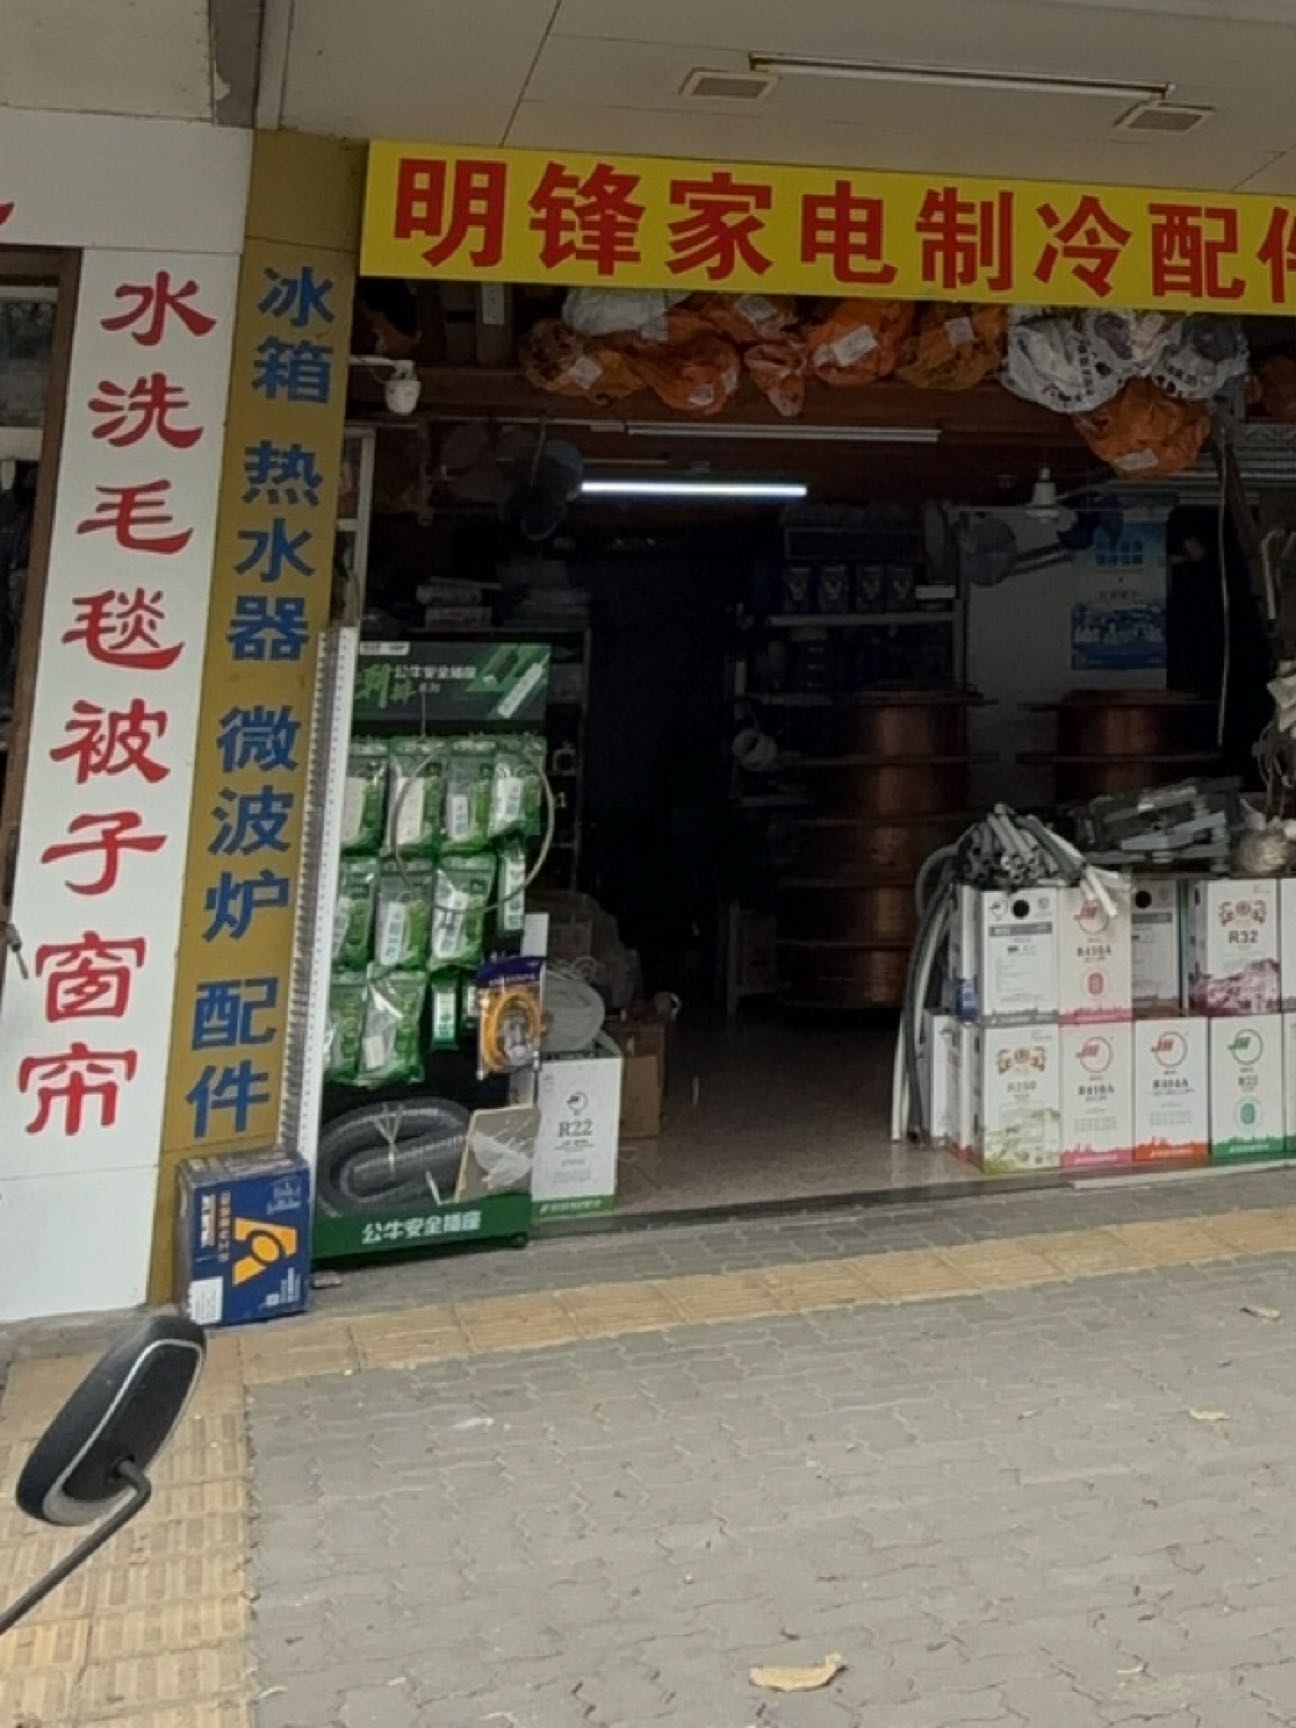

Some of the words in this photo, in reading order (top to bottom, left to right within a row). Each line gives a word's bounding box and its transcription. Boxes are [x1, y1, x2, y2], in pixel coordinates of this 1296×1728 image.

[251, 266, 335, 405] 冰箱
[227, 439, 324, 663] 热水器
[18, 270, 217, 1137] 水洗毛毯被子窗帘
[200, 704, 301, 944] 微波炉
[184, 976, 280, 1140] 配件
